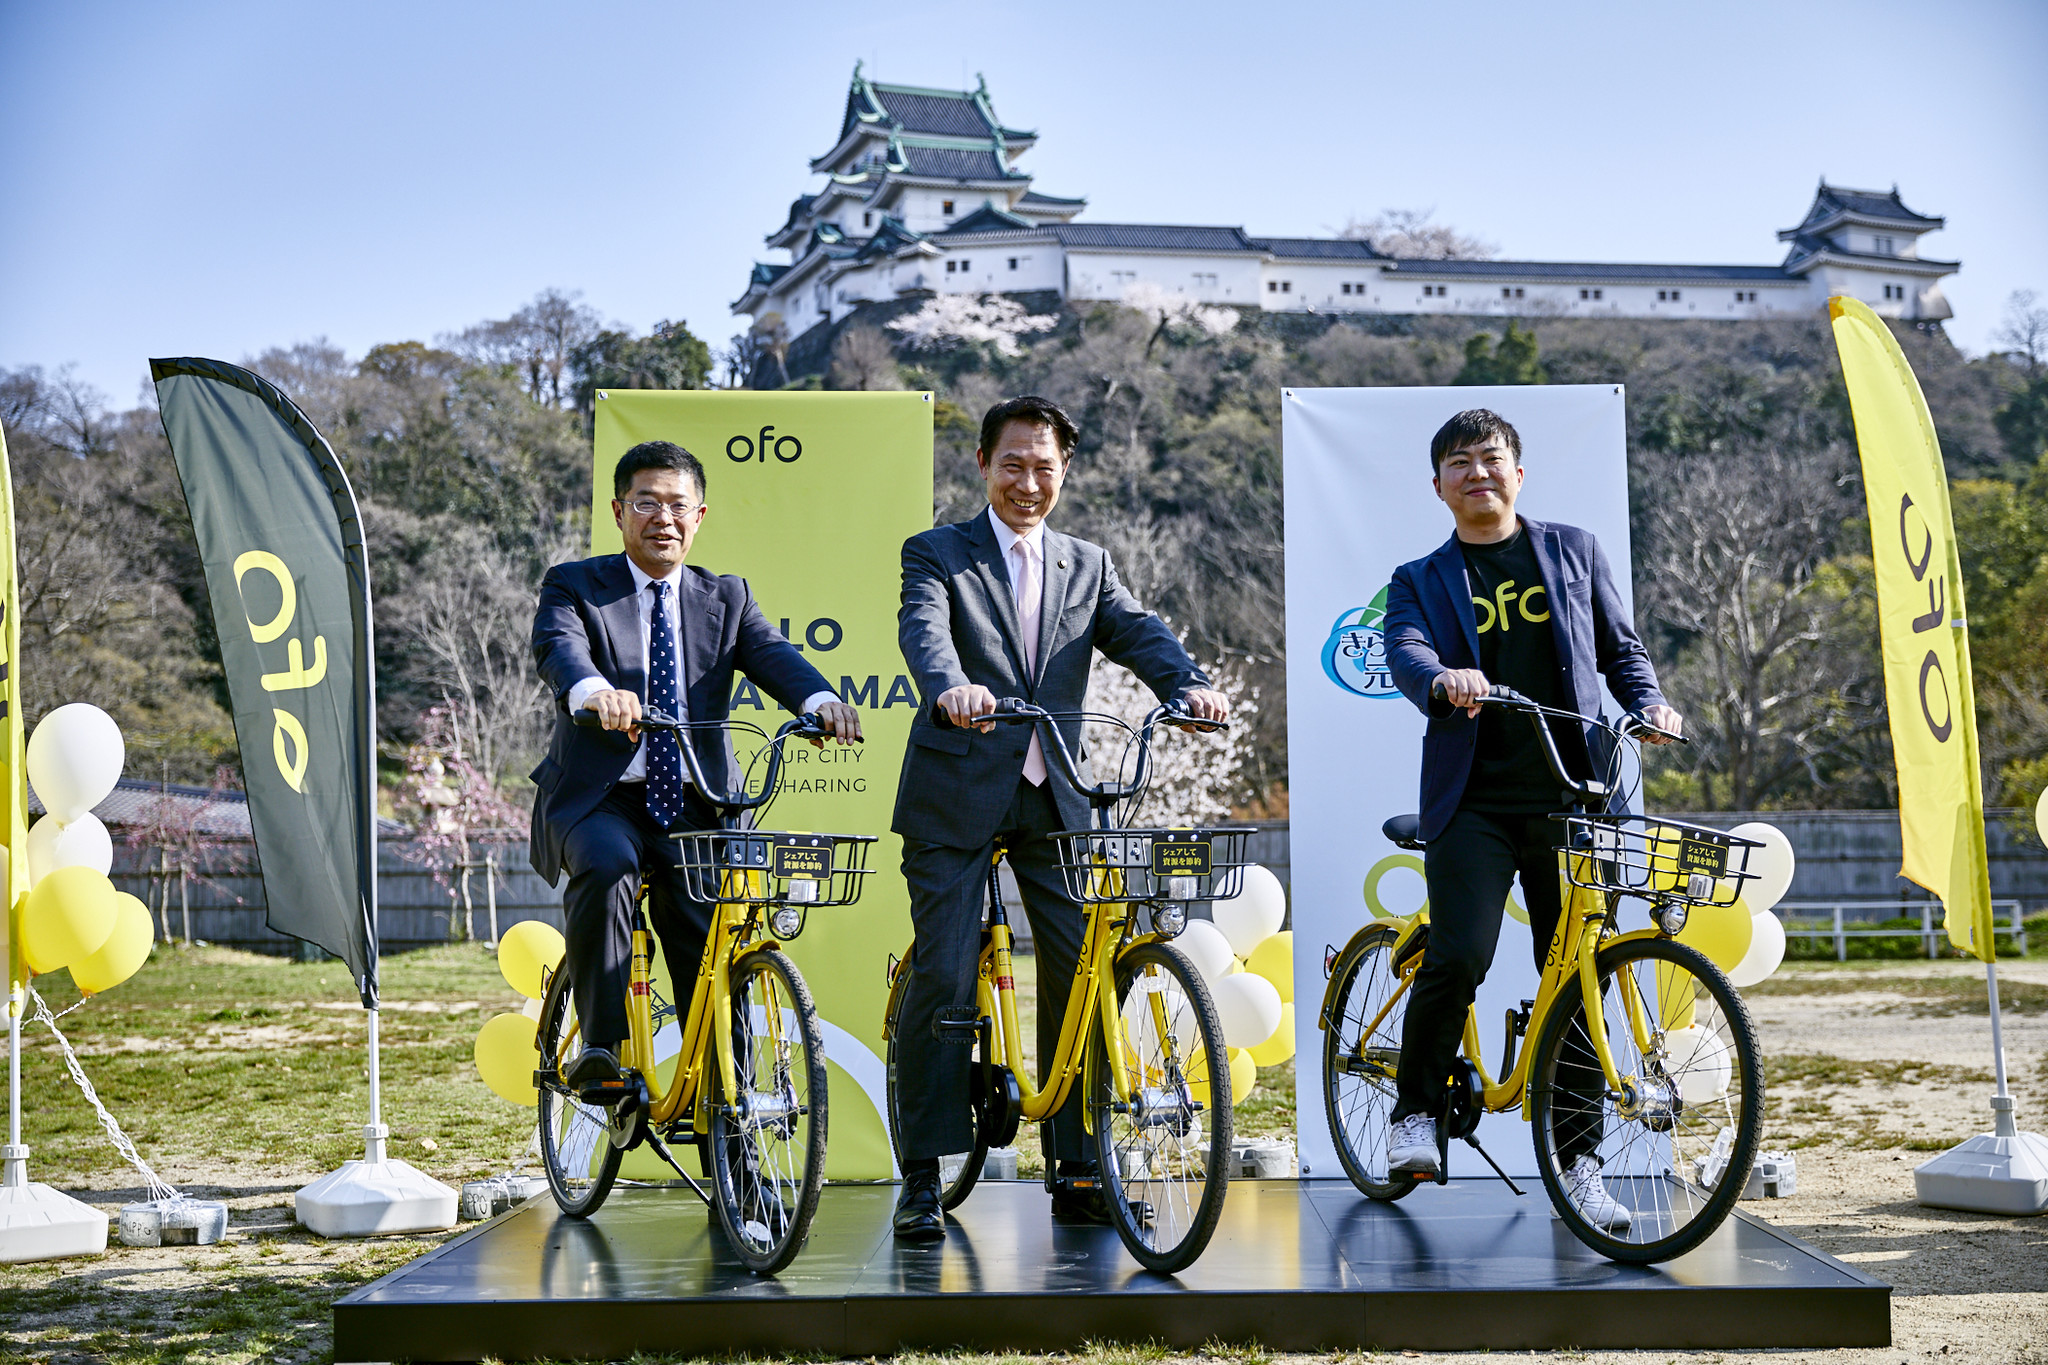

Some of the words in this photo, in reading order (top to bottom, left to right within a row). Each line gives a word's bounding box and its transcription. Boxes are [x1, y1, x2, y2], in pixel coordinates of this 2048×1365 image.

[726, 426, 802, 463] ofo
[819, 749, 864, 764] CITY
[783, 851, 818, 861] シェアして
[1162, 848, 1197, 857] シェアして
[1687, 845, 1717, 858] シェアして
